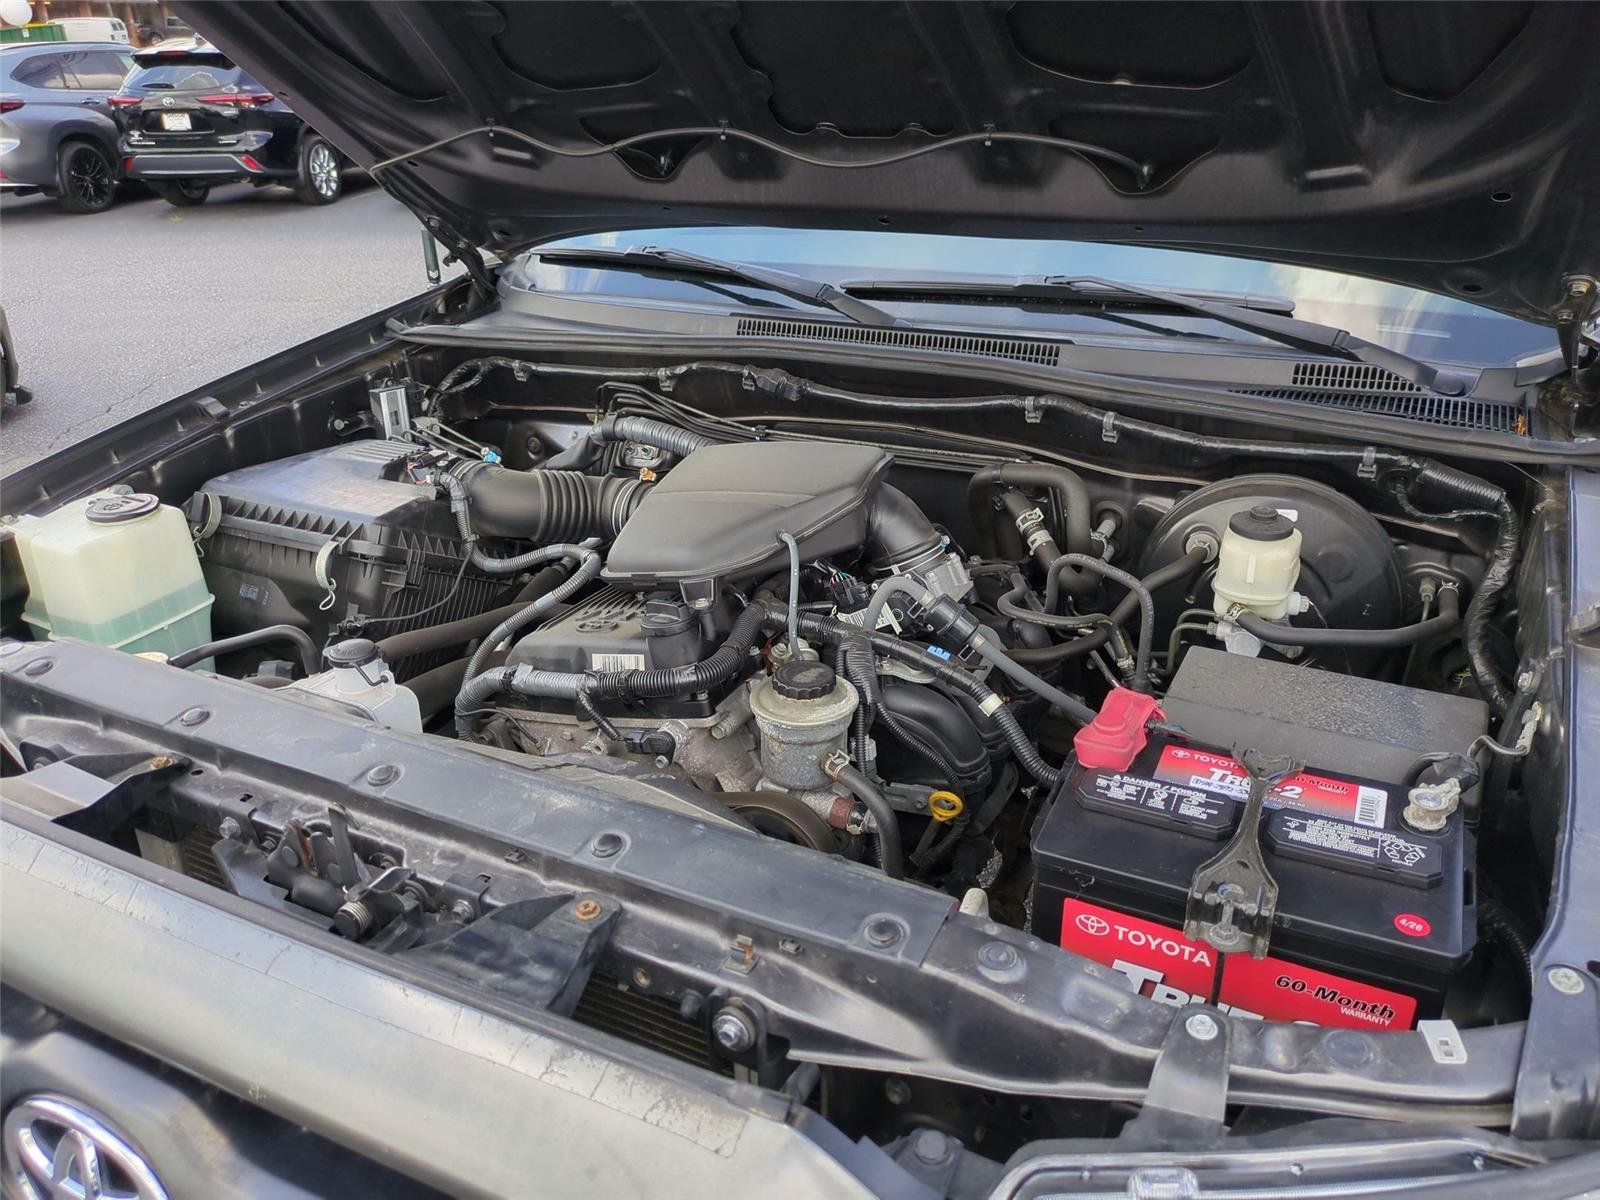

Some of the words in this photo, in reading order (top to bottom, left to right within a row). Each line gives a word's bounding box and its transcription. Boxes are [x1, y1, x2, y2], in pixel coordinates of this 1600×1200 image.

[1192, 753, 1239, 774] TOYOT
[1122, 776, 1162, 788] DANGER
[1171, 786, 1208, 799] POISON
[1114, 924, 1211, 967] TOYOTA
[1275, 975, 1396, 1019] 60-Month
[1340, 1007, 1391, 1027] WARRANTY
